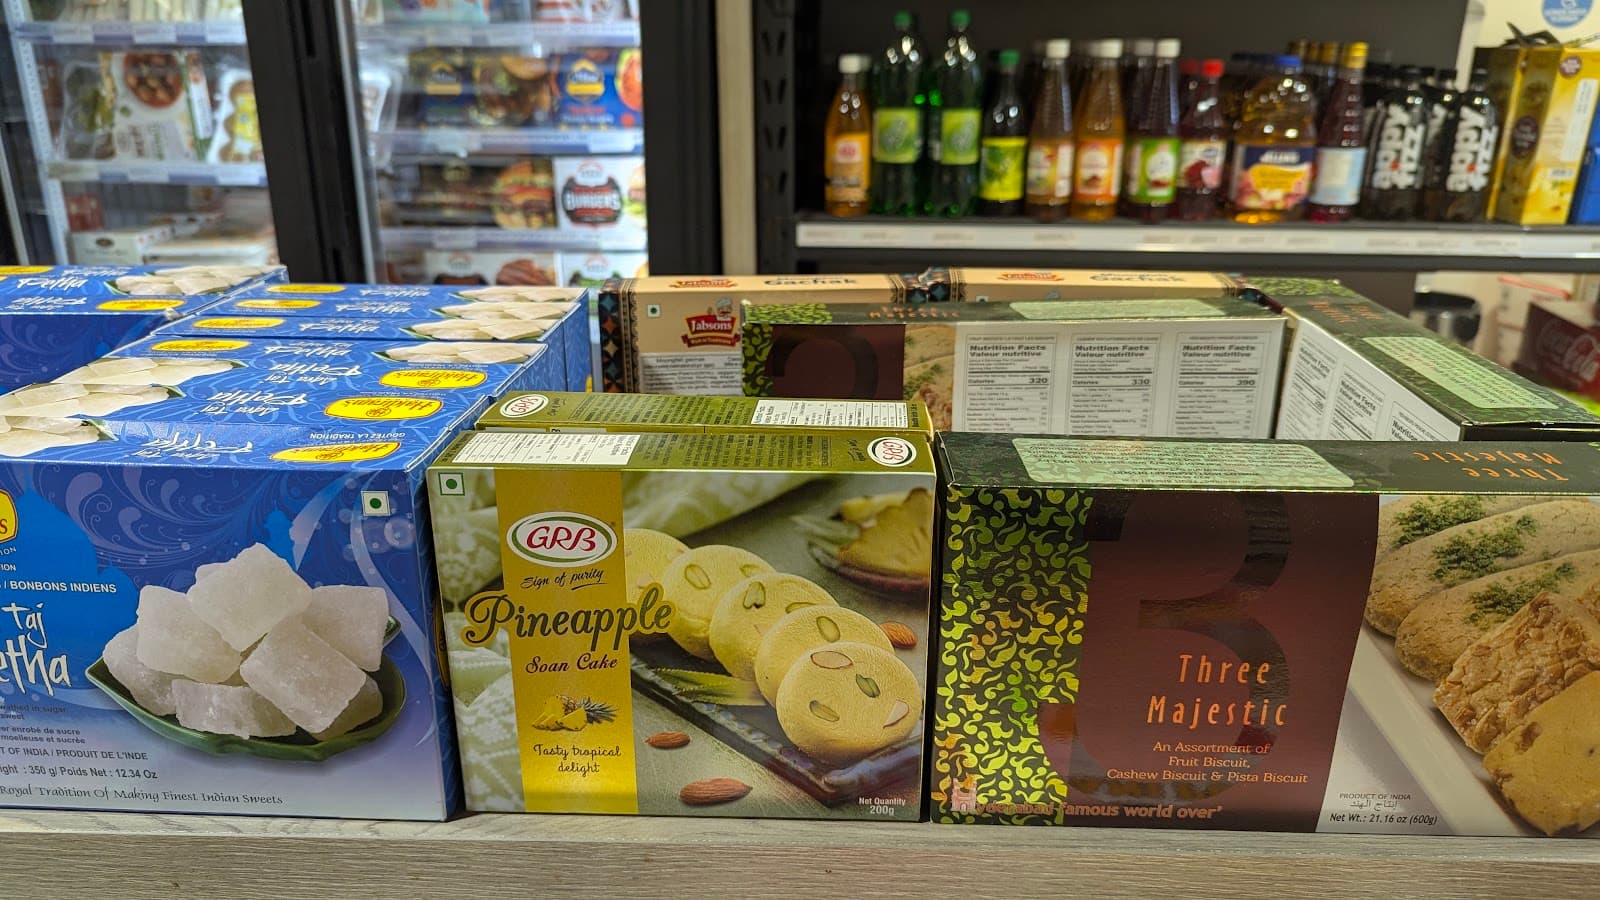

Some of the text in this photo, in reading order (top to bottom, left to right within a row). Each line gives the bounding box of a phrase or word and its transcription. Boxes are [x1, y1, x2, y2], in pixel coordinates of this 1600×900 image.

[690, 320, 732, 332] Jabsons
[269, 364, 362, 376] Petha
[206, 390, 309, 406] Petha
[342, 398, 437, 410] Haldiram's
[140, 432, 253, 454] Petha
[882, 440, 905, 462] GRB
[1412, 450, 1562, 465] Majestic
[1460, 467, 1569, 482] Three
[526, 526, 596, 552] GRB
[520, 568, 604, 590] Sign of purity
[10, 580, 68, 592] BONBONS
[70, 584, 117, 594] INDIENS
[465, 583, 672, 652] Pineapple
[526, 652, 618, 674] Soan Cake
[1178, 654, 1270, 684] Three
[1146, 695, 1288, 730] Majestic
[0, 734, 44, 742] moelleuse
[8, 748, 21, 756] OF
[24, 749, 49, 757] INDIA
[56, 750, 98, 758] PRODUIT
[117, 752, 149, 760] L'INDE
[533, 743, 622, 762] Tasty tropical
[1153, 742, 1271, 754] An Assortment of
[557, 762, 600, 778] delight
[1168, 756, 1250, 770] Fruit Biscuit,
[28, 766, 47, 775] 350
[60, 767, 88, 777] Poids
[90, 768, 106, 777] Net
[116, 768, 142, 778] 12.34
[143, 770, 158, 780] Oz
[1106, 768, 1309, 784] Cashew Biscuit & Pista Biscuit
[0, 784, 284, 804] Royal Tradition Of Making Finest Indian Sweets
[858, 796, 906, 808] Net Quantity
[869, 806, 895, 817] 200g
[1059, 802, 1120, 817] famous
[1123, 804, 1174, 818] world
[1330, 813, 1345, 822] Net
[1348, 814, 1368, 823] Wt.:
[1368, 814, 1395, 824] 21.16
[1409, 815, 1438, 826] (600g)
